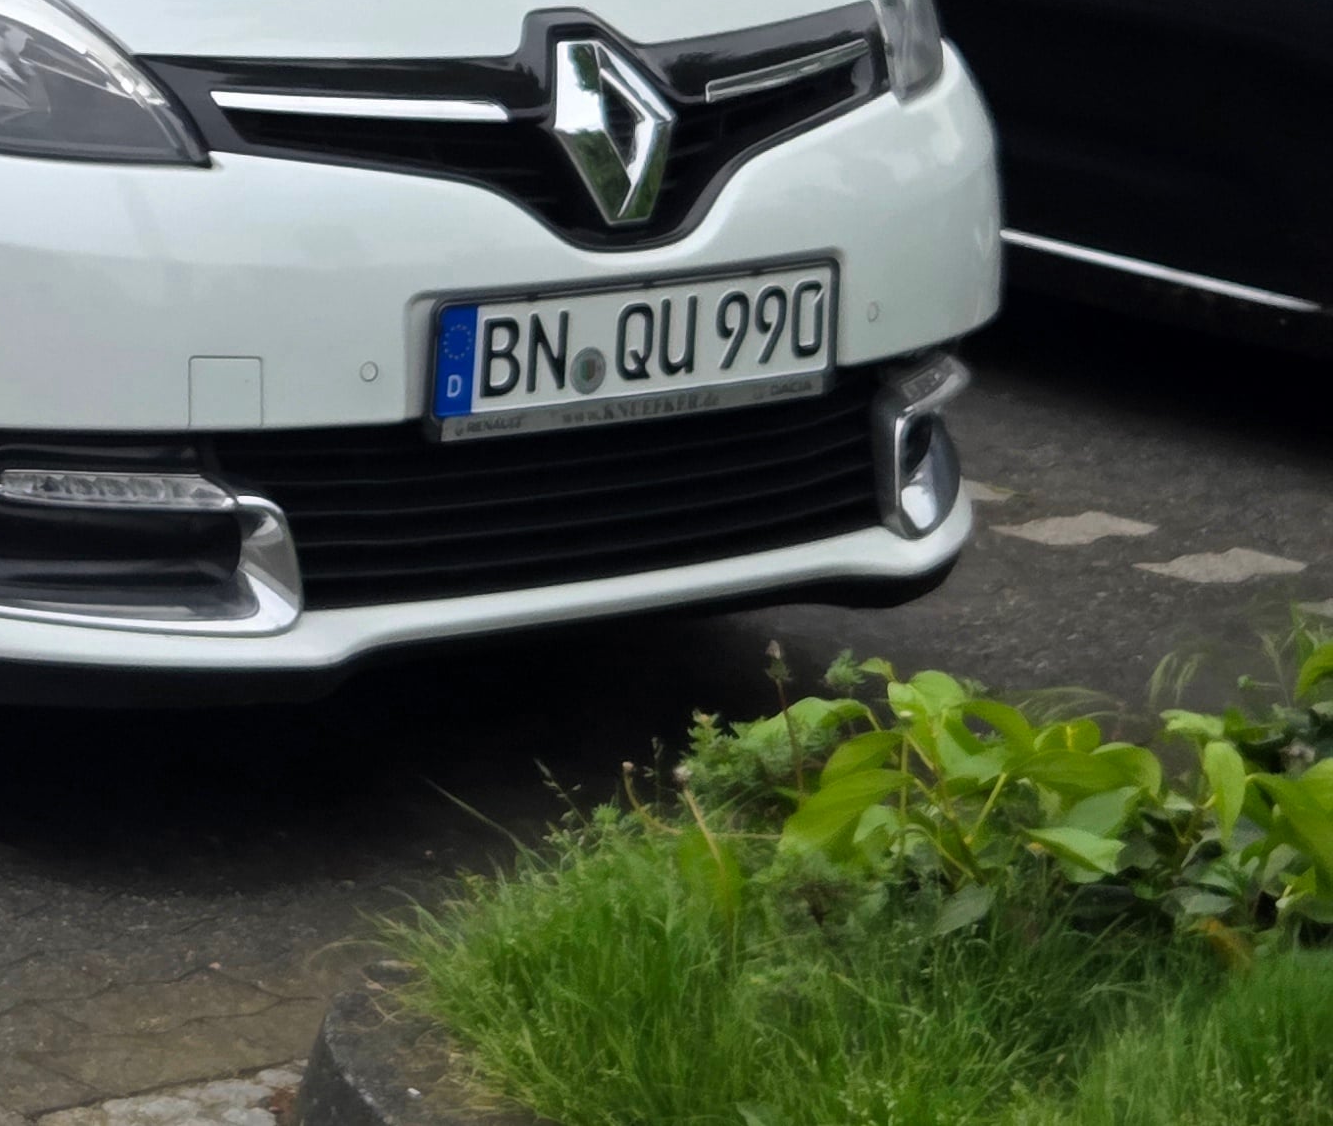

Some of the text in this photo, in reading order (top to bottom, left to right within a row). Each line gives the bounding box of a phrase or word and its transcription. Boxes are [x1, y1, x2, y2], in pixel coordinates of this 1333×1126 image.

[479, 280, 825, 399] BN QU 990
[446, 374, 463, 398] D
